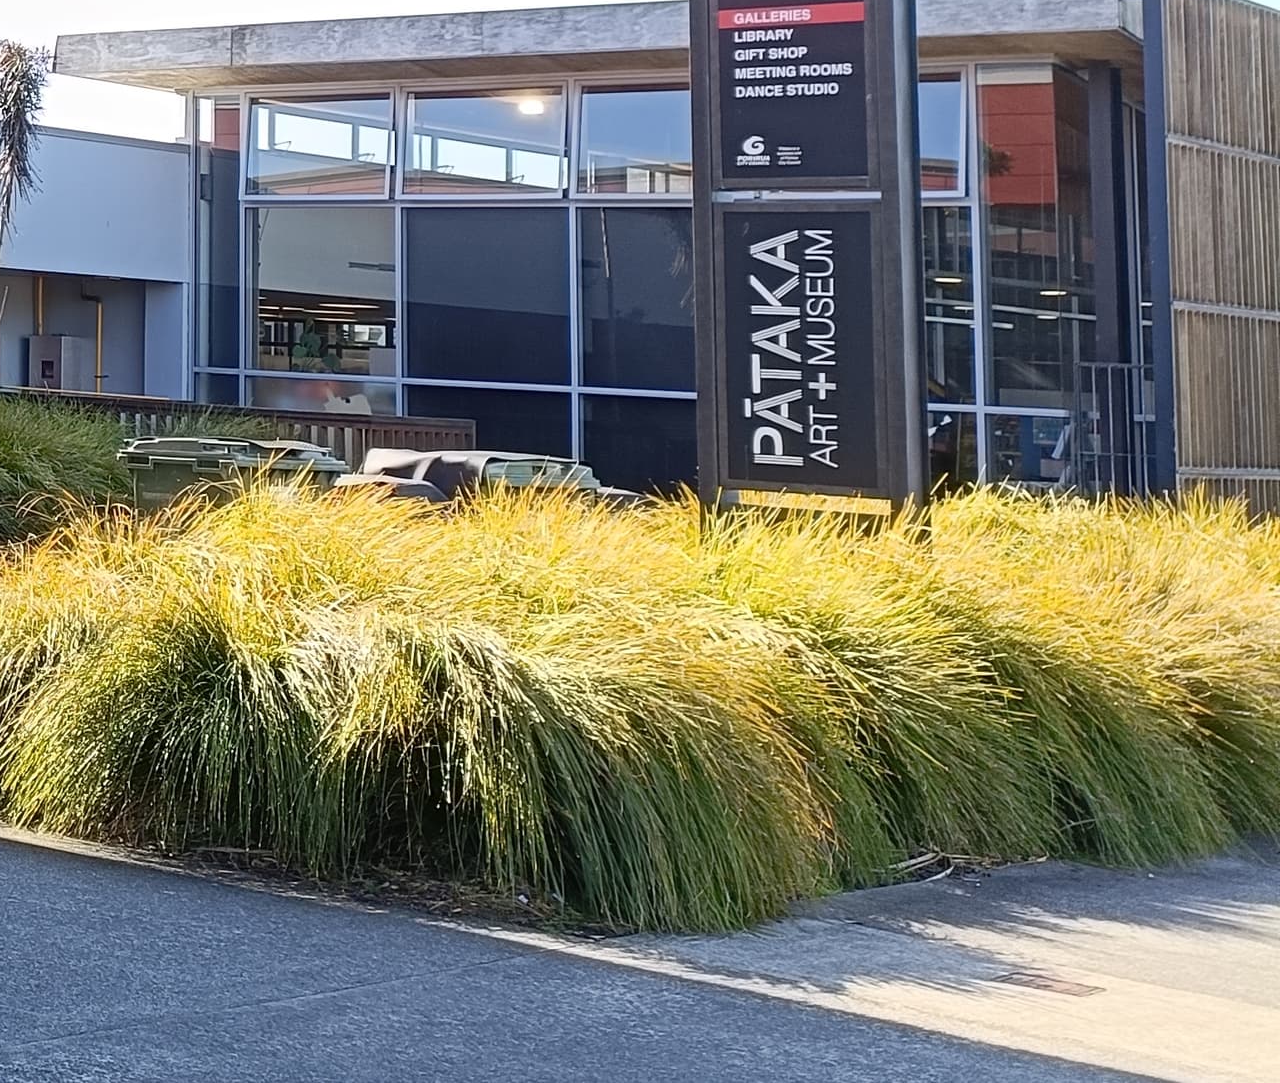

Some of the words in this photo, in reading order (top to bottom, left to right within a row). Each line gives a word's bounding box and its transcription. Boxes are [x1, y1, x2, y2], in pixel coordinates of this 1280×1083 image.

[734, 9, 811, 24] GALLERIES
[734, 29, 793, 42] LIBRARY
[735, 49, 765, 61] GIFT
[768, 47, 807, 59] SHOP
[735, 66, 796, 79] MEETING
[800, 63, 852, 76] ROOMS
[735, 85, 783, 97] DANCE
[786, 83, 839, 96] STUDIO
[805, 229, 834, 365] MUSEUM
[744, 229, 804, 467] PĀTAKA
